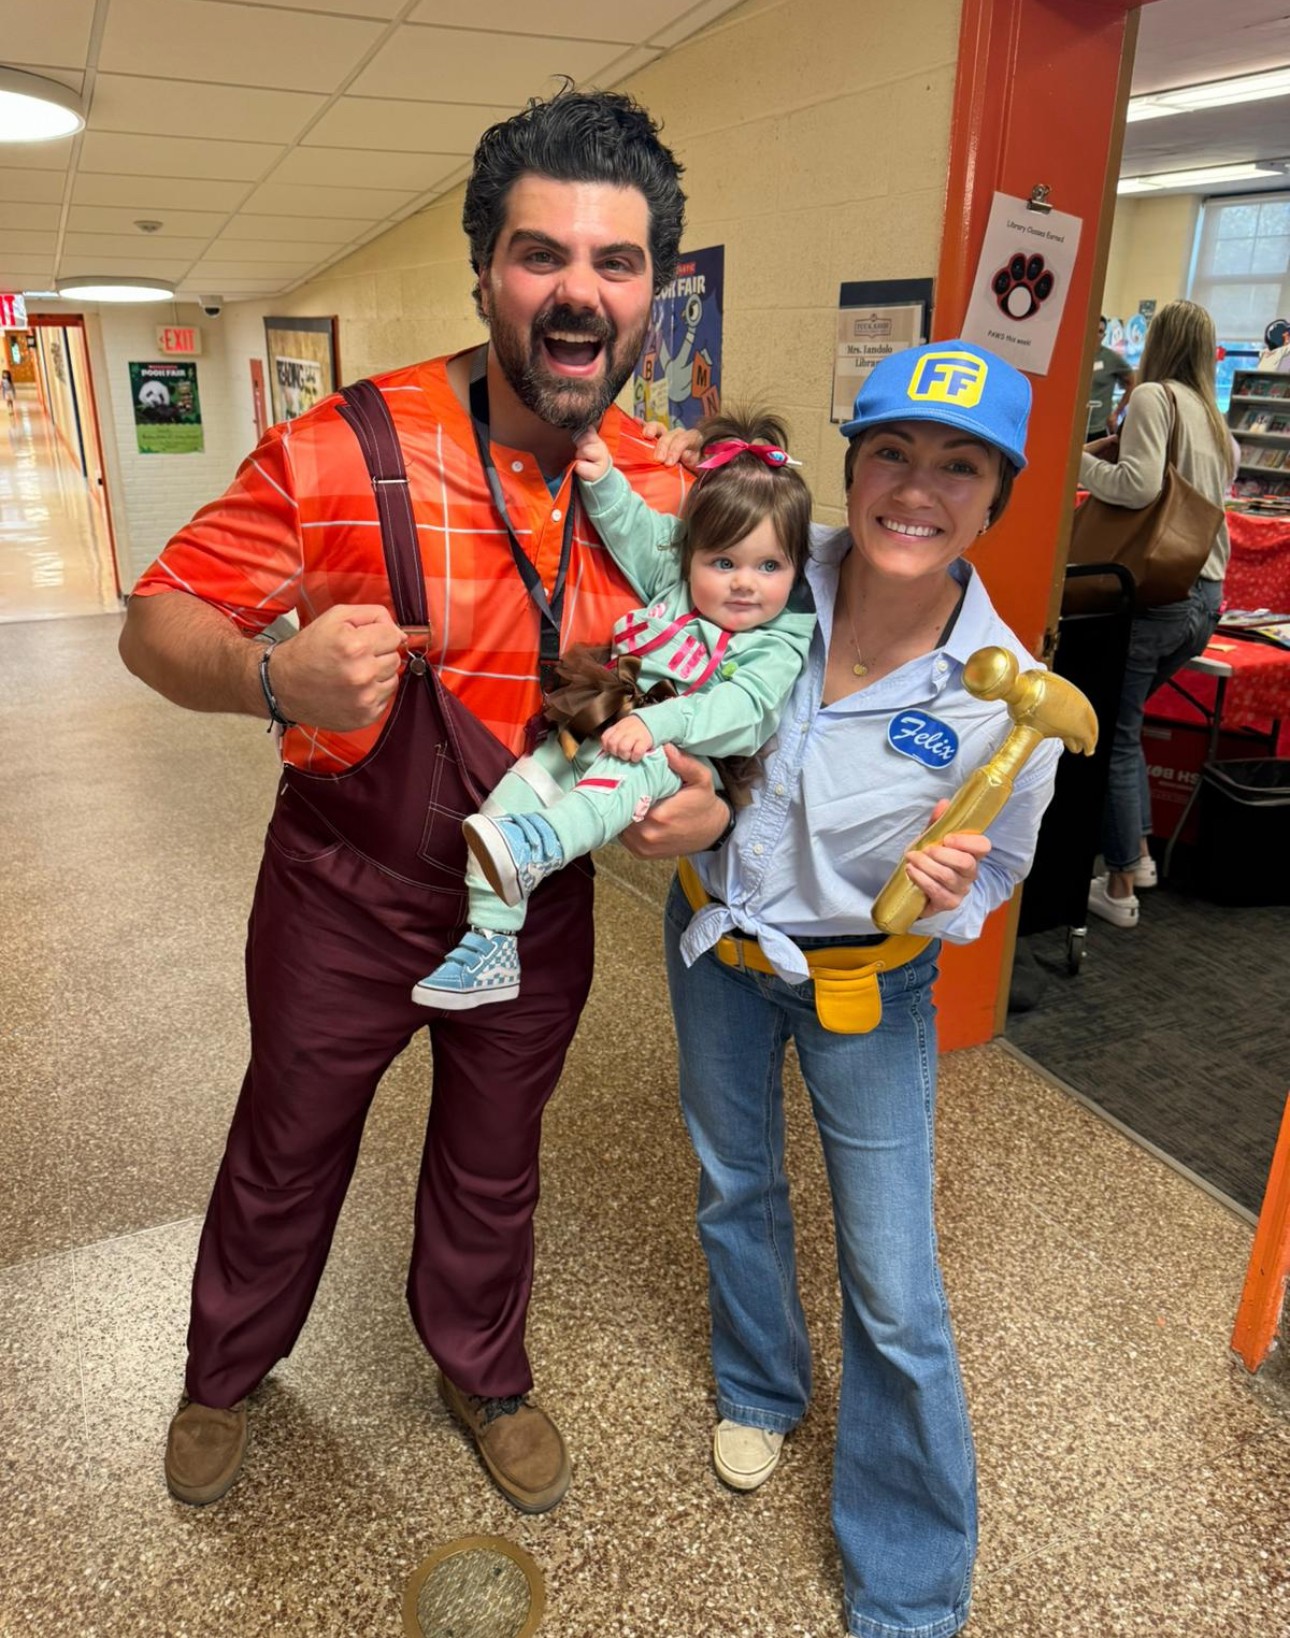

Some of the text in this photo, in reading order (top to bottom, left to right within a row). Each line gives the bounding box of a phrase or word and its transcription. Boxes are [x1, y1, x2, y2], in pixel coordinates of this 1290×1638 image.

[1006, 219, 1026, 233] Library
[677, 275, 706, 297] FAIR
[164, 328, 195, 352] EXIT
[847, 344, 862, 354] Mrs.
[697, 364, 707, 388] M
[915, 358, 981, 396] FF
[892, 716, 956, 760] Felix
